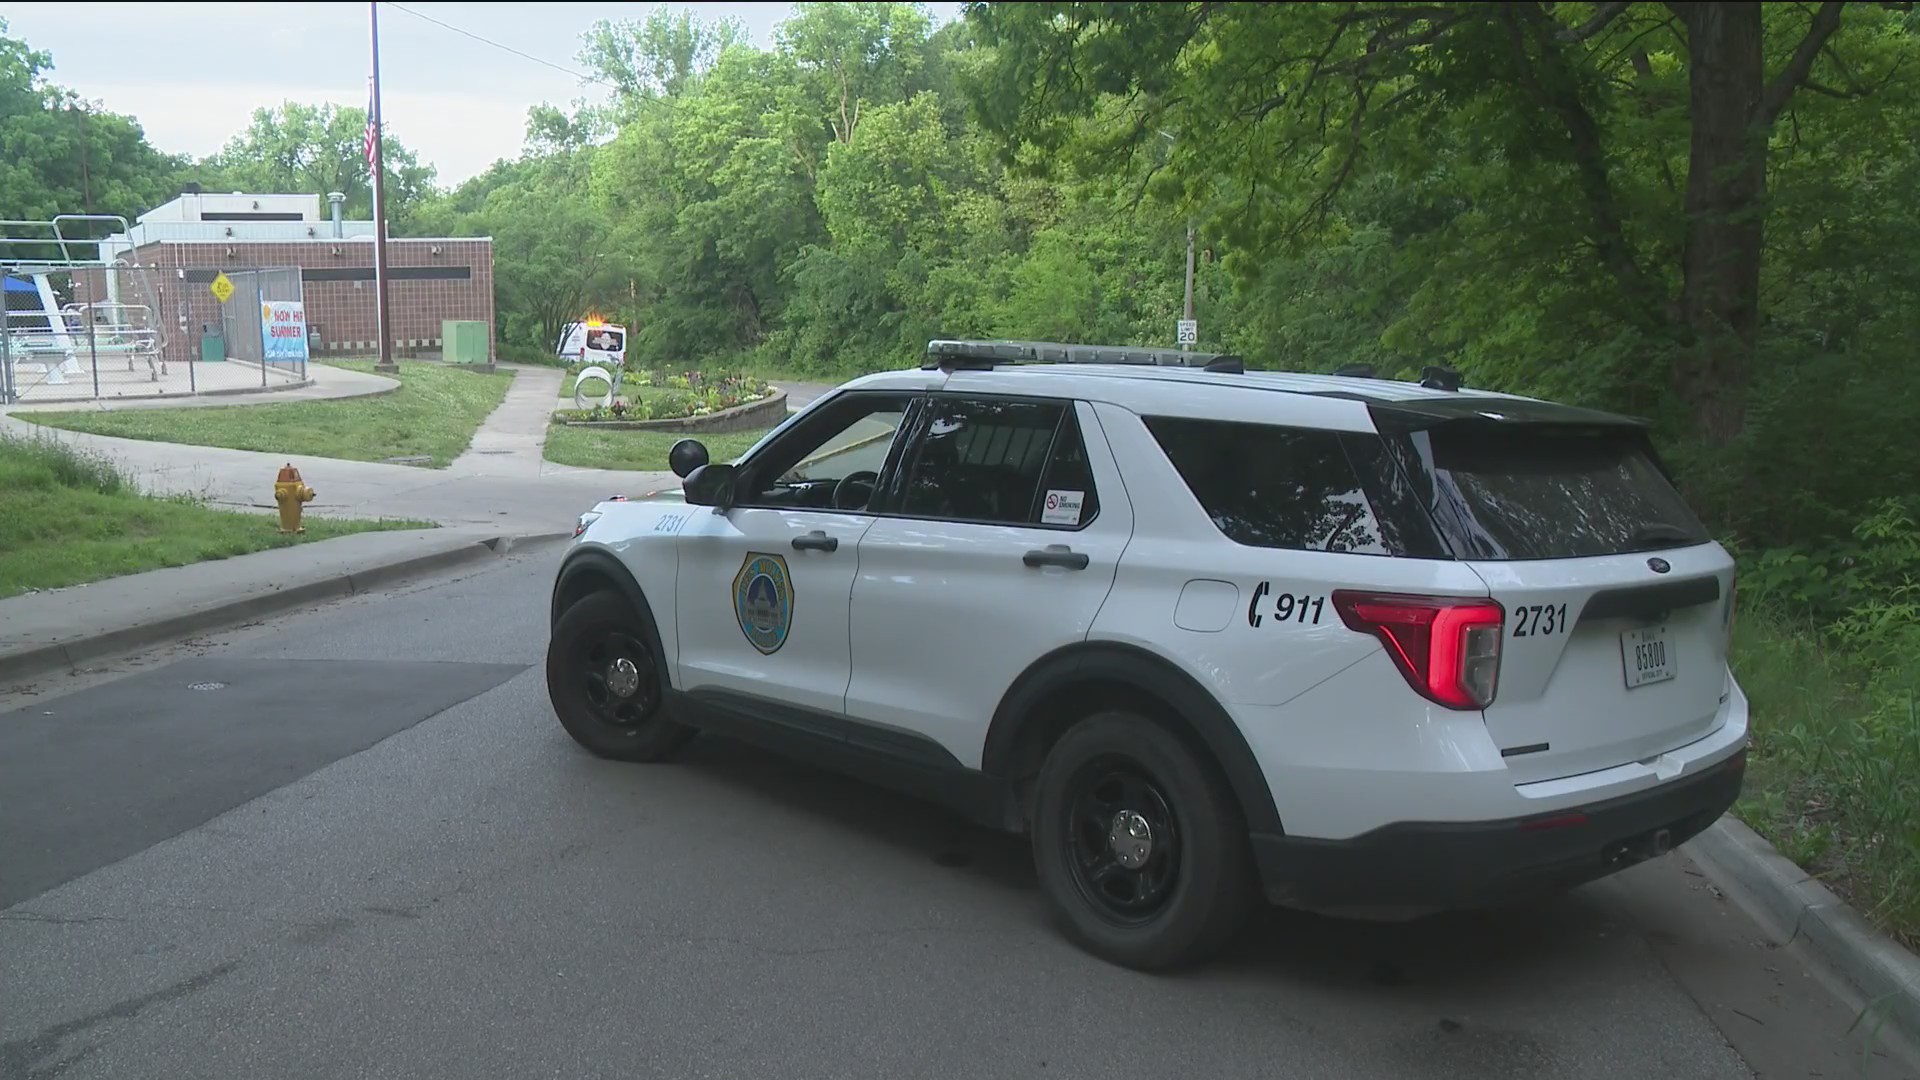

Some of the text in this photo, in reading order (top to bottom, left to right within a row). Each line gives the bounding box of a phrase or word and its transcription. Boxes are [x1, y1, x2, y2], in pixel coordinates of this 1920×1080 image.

[274, 310, 290, 322] NOW
[271, 325, 301, 338] SUMMER
[1180, 332, 1195, 341] 20
[654, 514, 684, 533] 2731
[1274, 593, 1324, 625] 911
[1513, 602, 1567, 638] 2731
[1635, 640, 1666, 671] 85800
